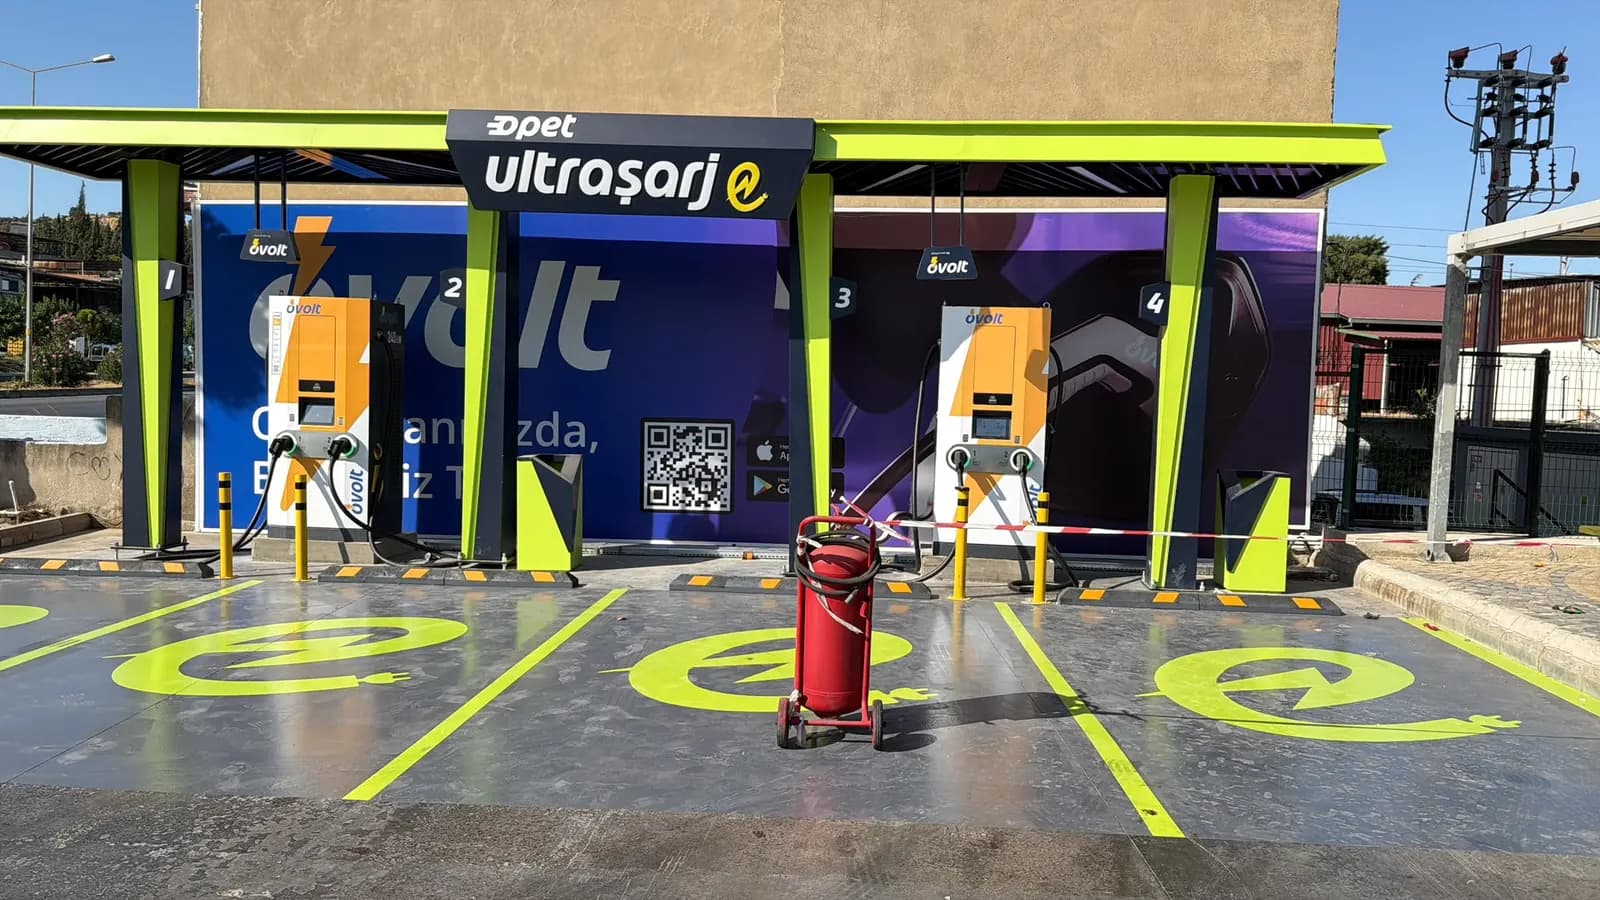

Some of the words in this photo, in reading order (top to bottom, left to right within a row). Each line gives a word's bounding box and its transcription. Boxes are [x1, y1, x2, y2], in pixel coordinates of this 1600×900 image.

[487, 114, 577, 140] opet
[485, 150, 720, 211] ultraşarj
[165, 269, 175, 289] 1
[444, 277, 462, 297] 2
[835, 288, 851, 308] 3
[1147, 292, 1164, 313] 4
